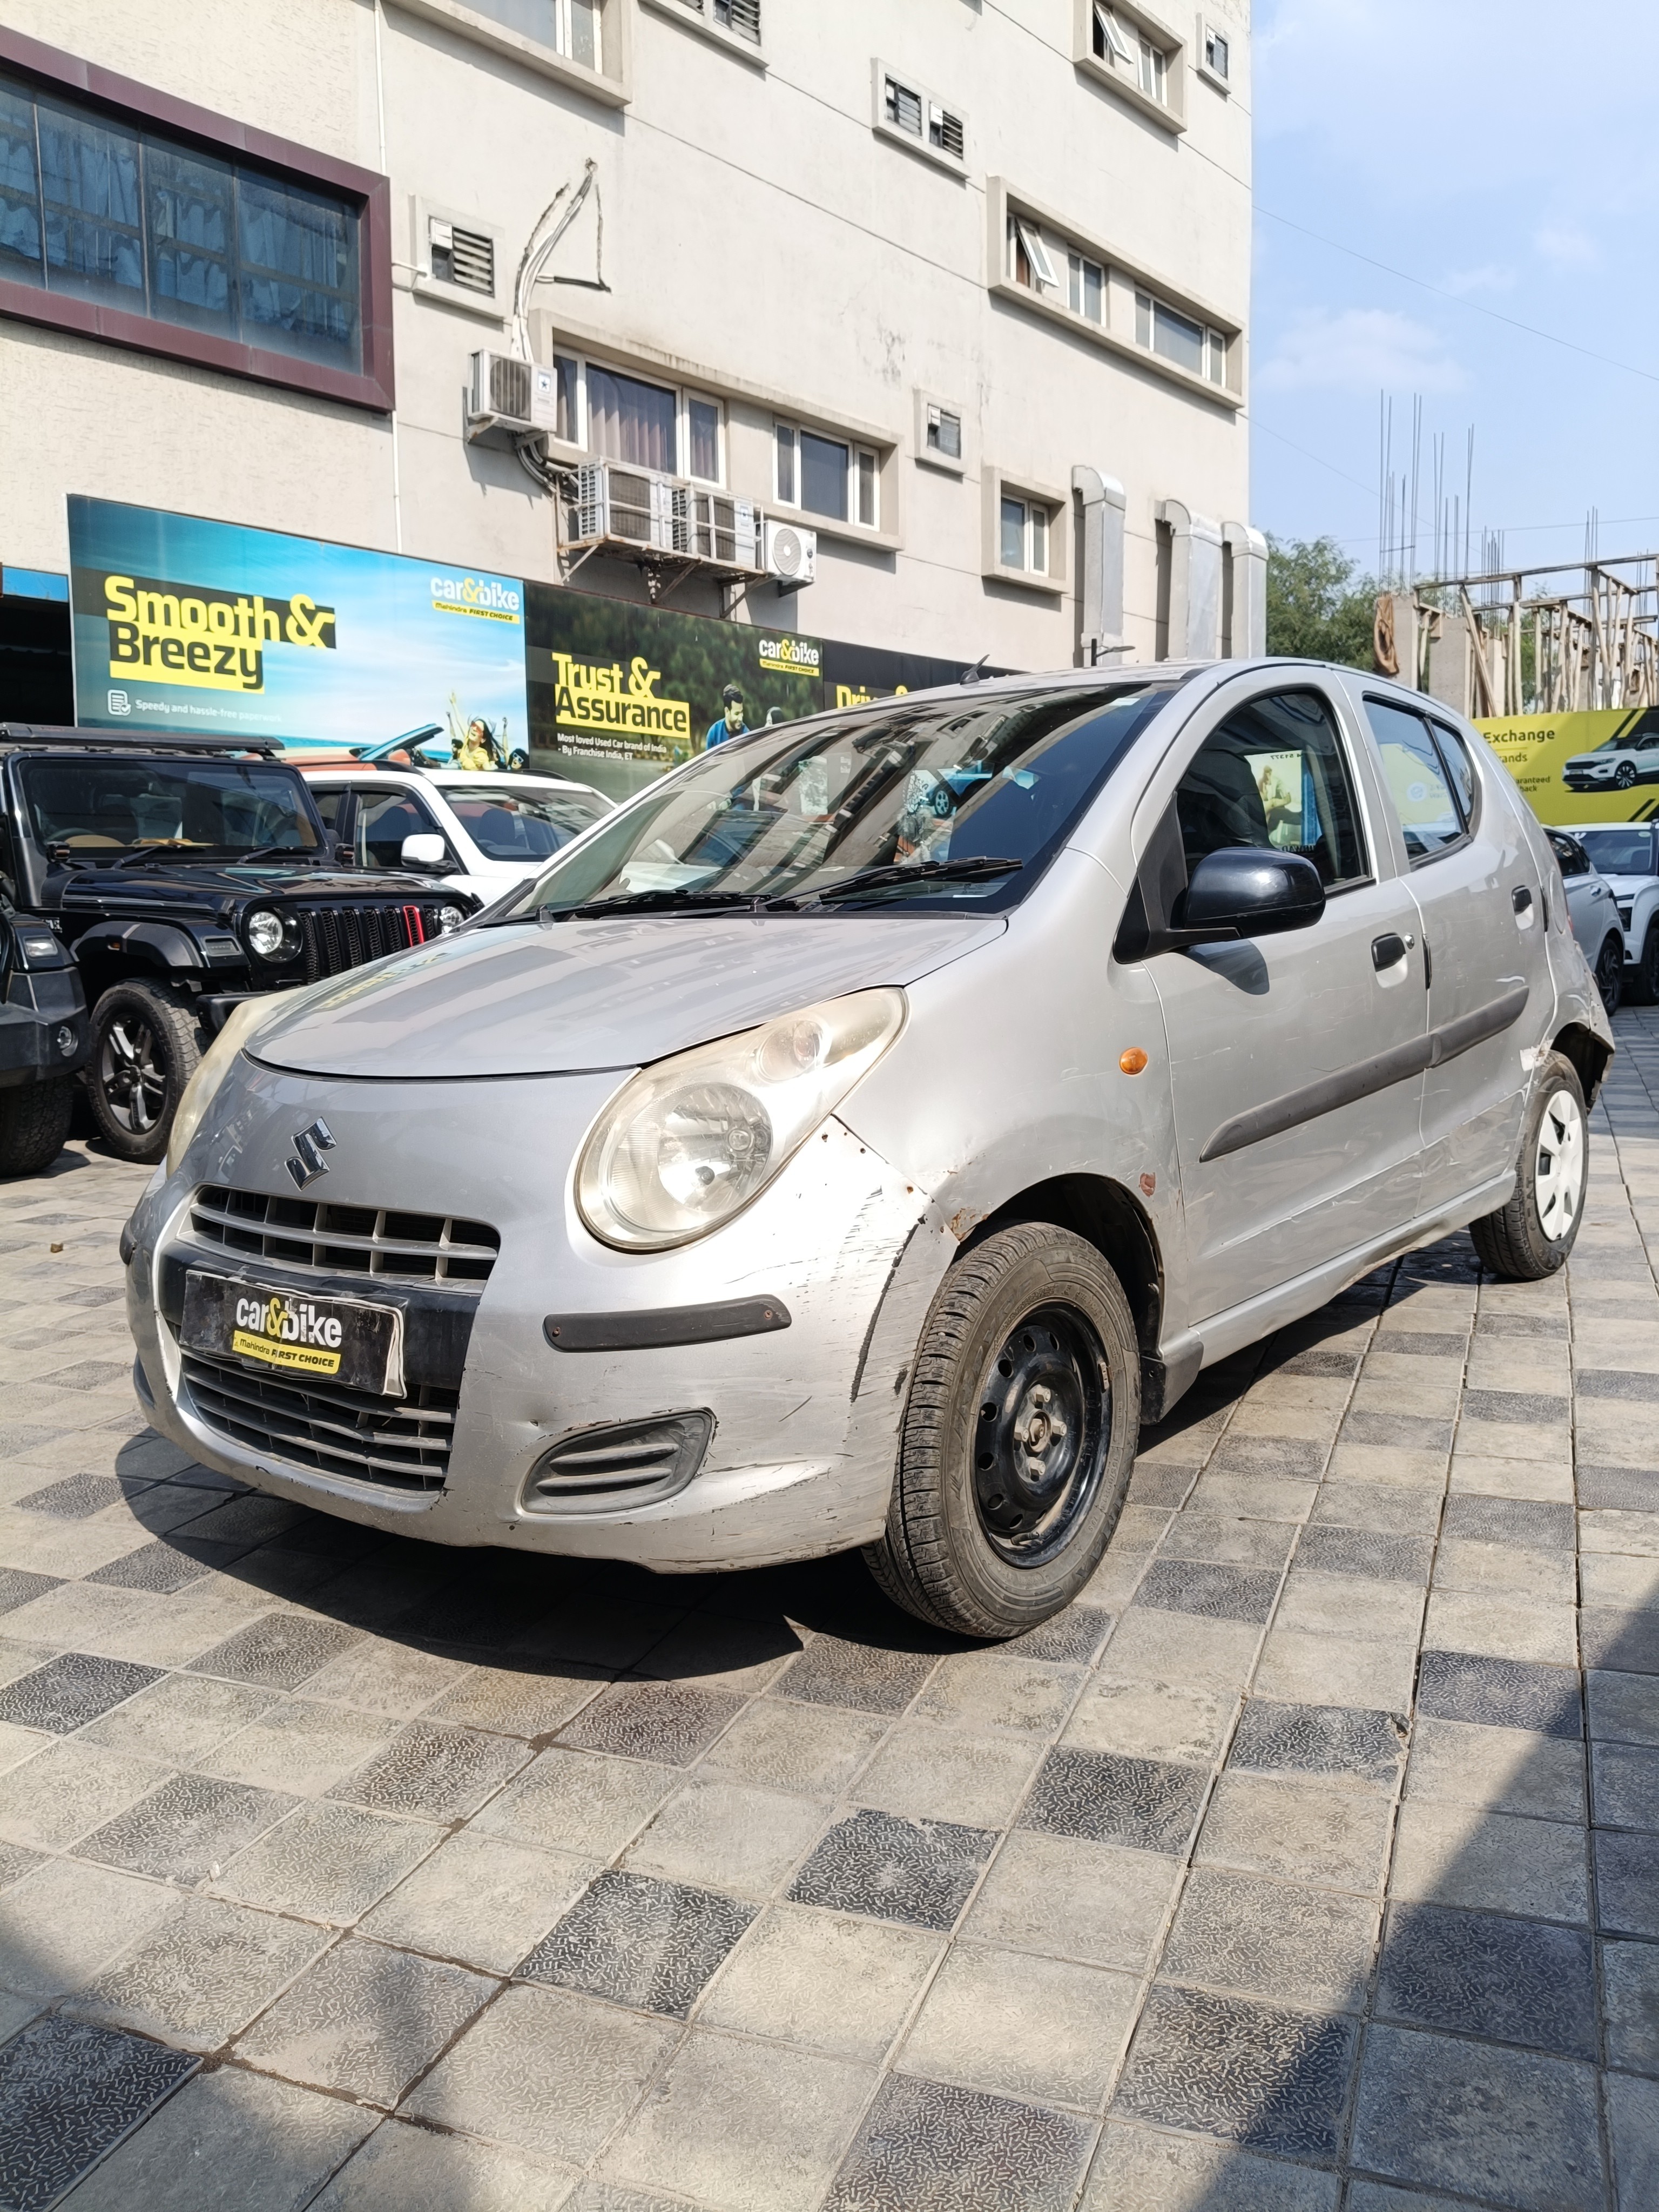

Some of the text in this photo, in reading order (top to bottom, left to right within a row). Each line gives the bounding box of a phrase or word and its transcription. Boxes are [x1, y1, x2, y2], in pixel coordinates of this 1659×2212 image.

[430, 577, 520, 611] car&bike
[104, 575, 336, 648] Smooth &
[469, 609, 489, 617] FIRST
[489, 612, 513, 621] CHOICE
[109, 621, 264, 690] Breezy
[759, 639, 819, 665] car&bike
[552, 652, 661, 698] Trust &
[135, 699, 282, 723] Speedy and hassle-free paperwork
[555, 686, 687, 732] Assurance
[557, 733, 575, 743] Most
[576, 735, 594, 745] loved
[595, 738, 611, 747] Used
[612, 739, 623, 748] Car
[624, 740, 643, 751] brand
[651, 744, 667, 753] India
[1483, 729, 1555, 743] Exchange
[562, 745, 572, 756] By
[573, 746, 605, 758] Franchise
[624, 752, 633, 760] ET
[236, 1297, 342, 1348] car&bike
[240, 1339, 269, 1354] Mahindra
[299, 1354, 335, 1367] CHOICE
